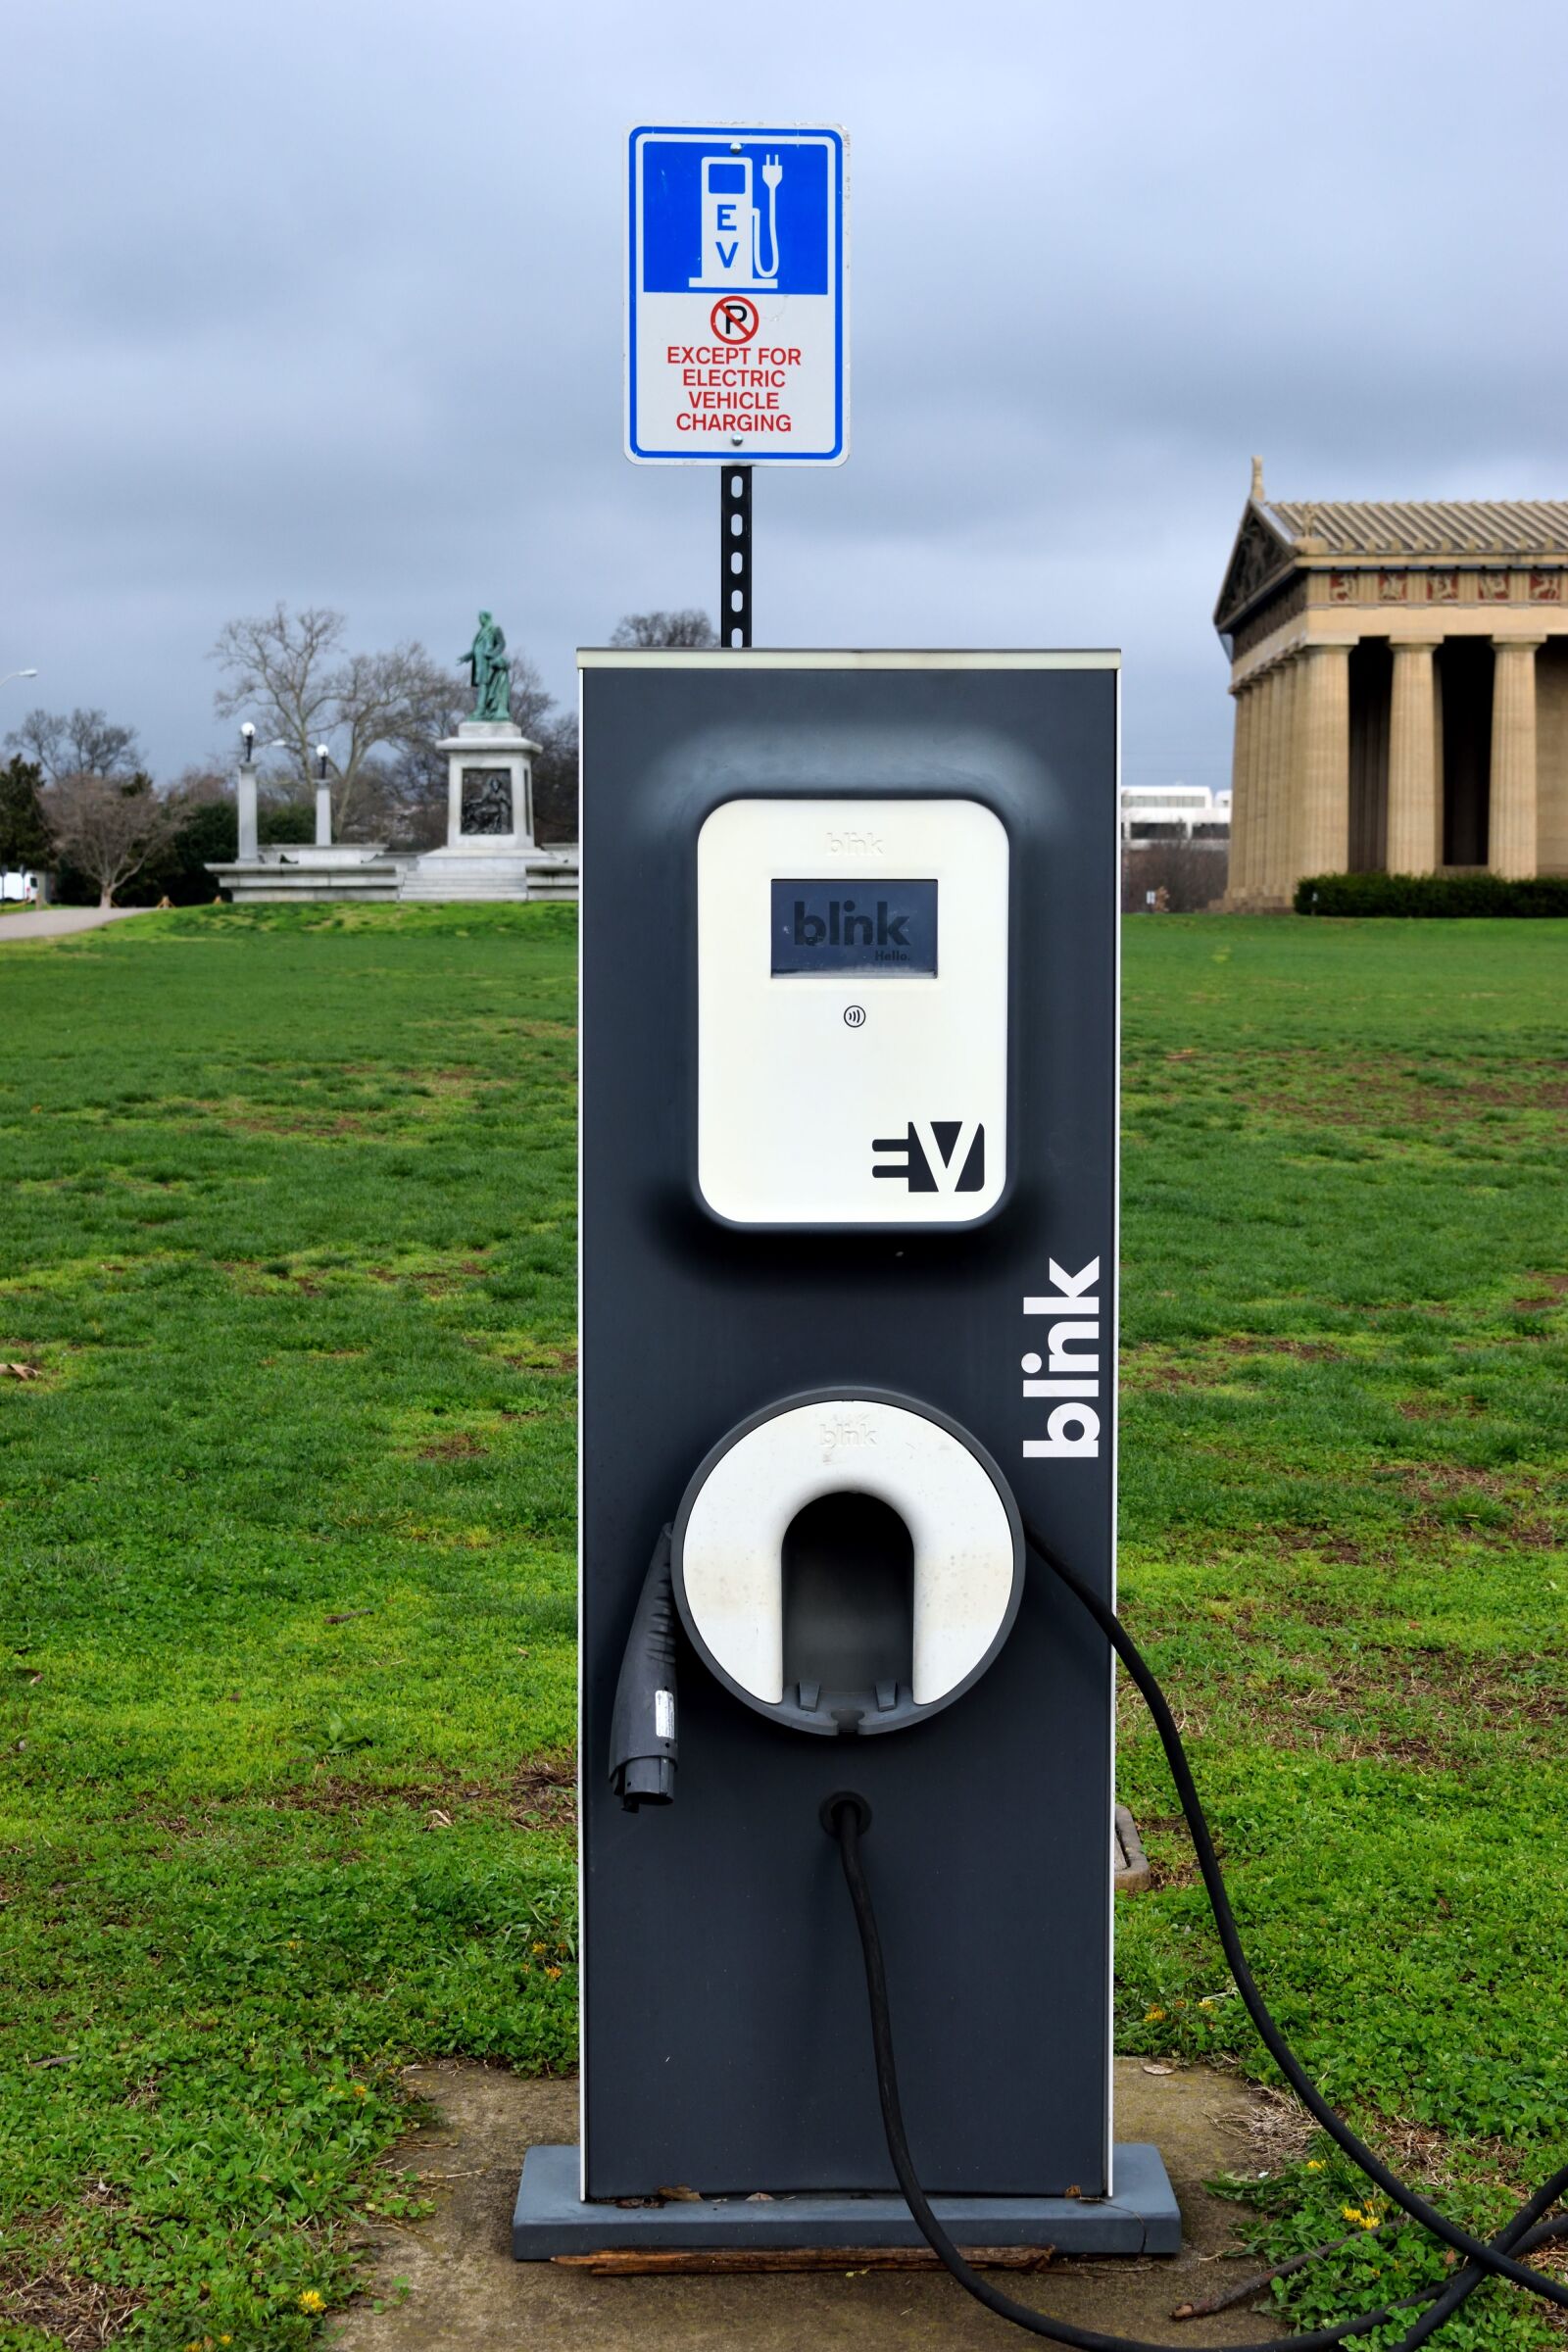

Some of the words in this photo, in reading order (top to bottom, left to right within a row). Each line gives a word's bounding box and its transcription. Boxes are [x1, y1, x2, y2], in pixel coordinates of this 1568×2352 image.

[666, 346, 752, 366] EXCEPT
[758, 348, 802, 366] FOR
[682, 369, 786, 388] ELECTRIC
[688, 392, 779, 410] VEHICLE
[675, 413, 792, 432] CHARGING
[825, 831, 885, 857] blink
[794, 900, 910, 947] blink
[1021, 1255, 1101, 1458] blink
[817, 1422, 878, 1447] blink
